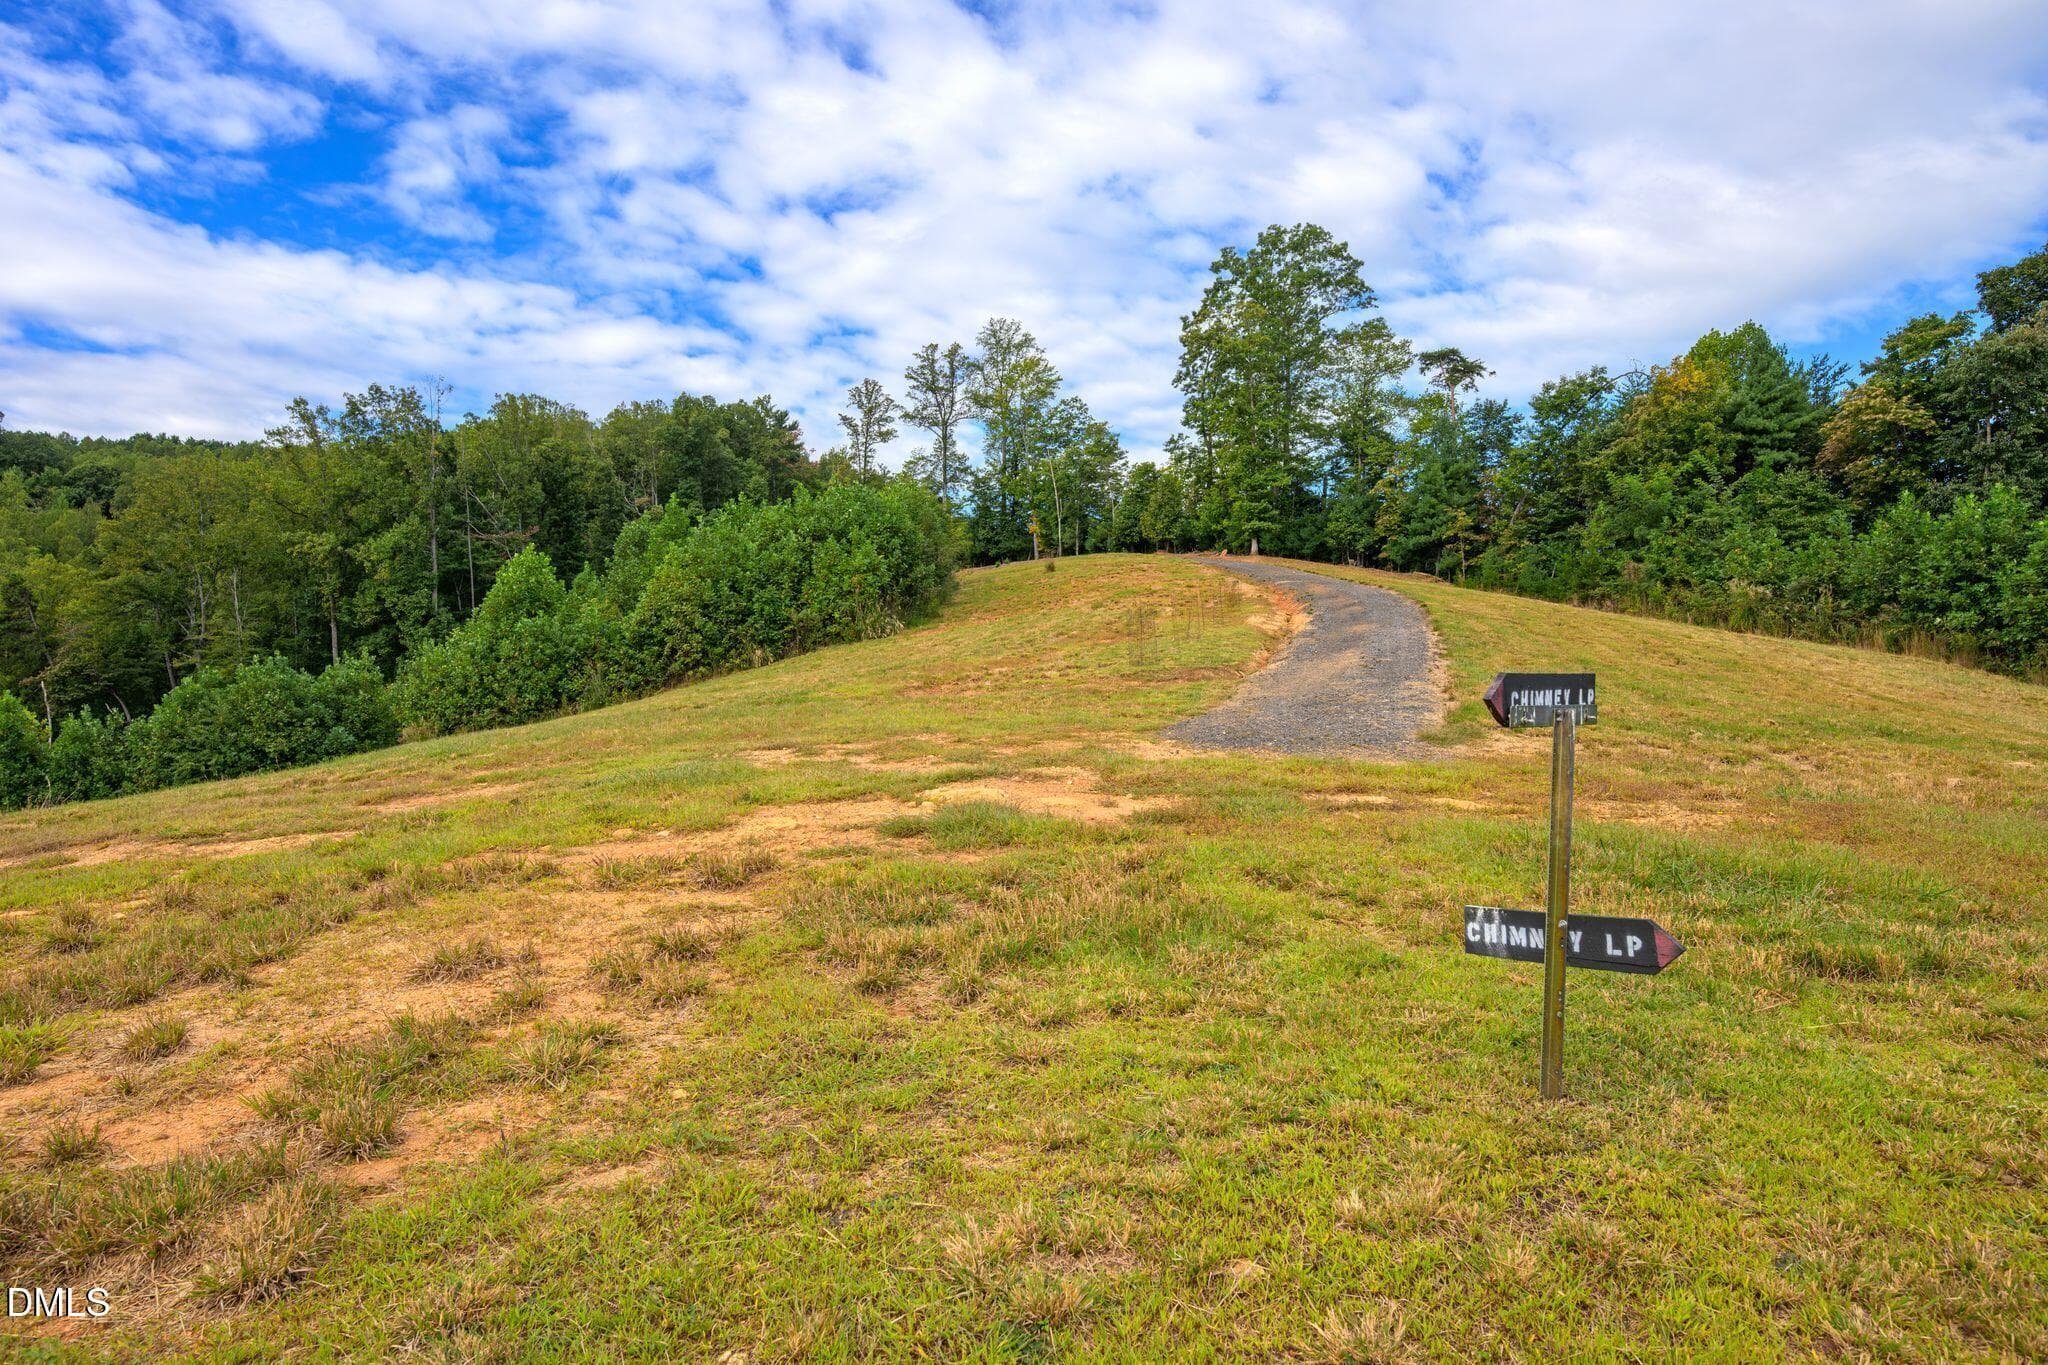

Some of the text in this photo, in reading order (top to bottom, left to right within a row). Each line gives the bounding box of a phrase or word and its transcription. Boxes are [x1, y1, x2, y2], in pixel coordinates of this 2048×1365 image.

[1511, 688, 1595, 707] CHIMNEY LP
[1467, 922, 1643, 957] CHIMNY LP
